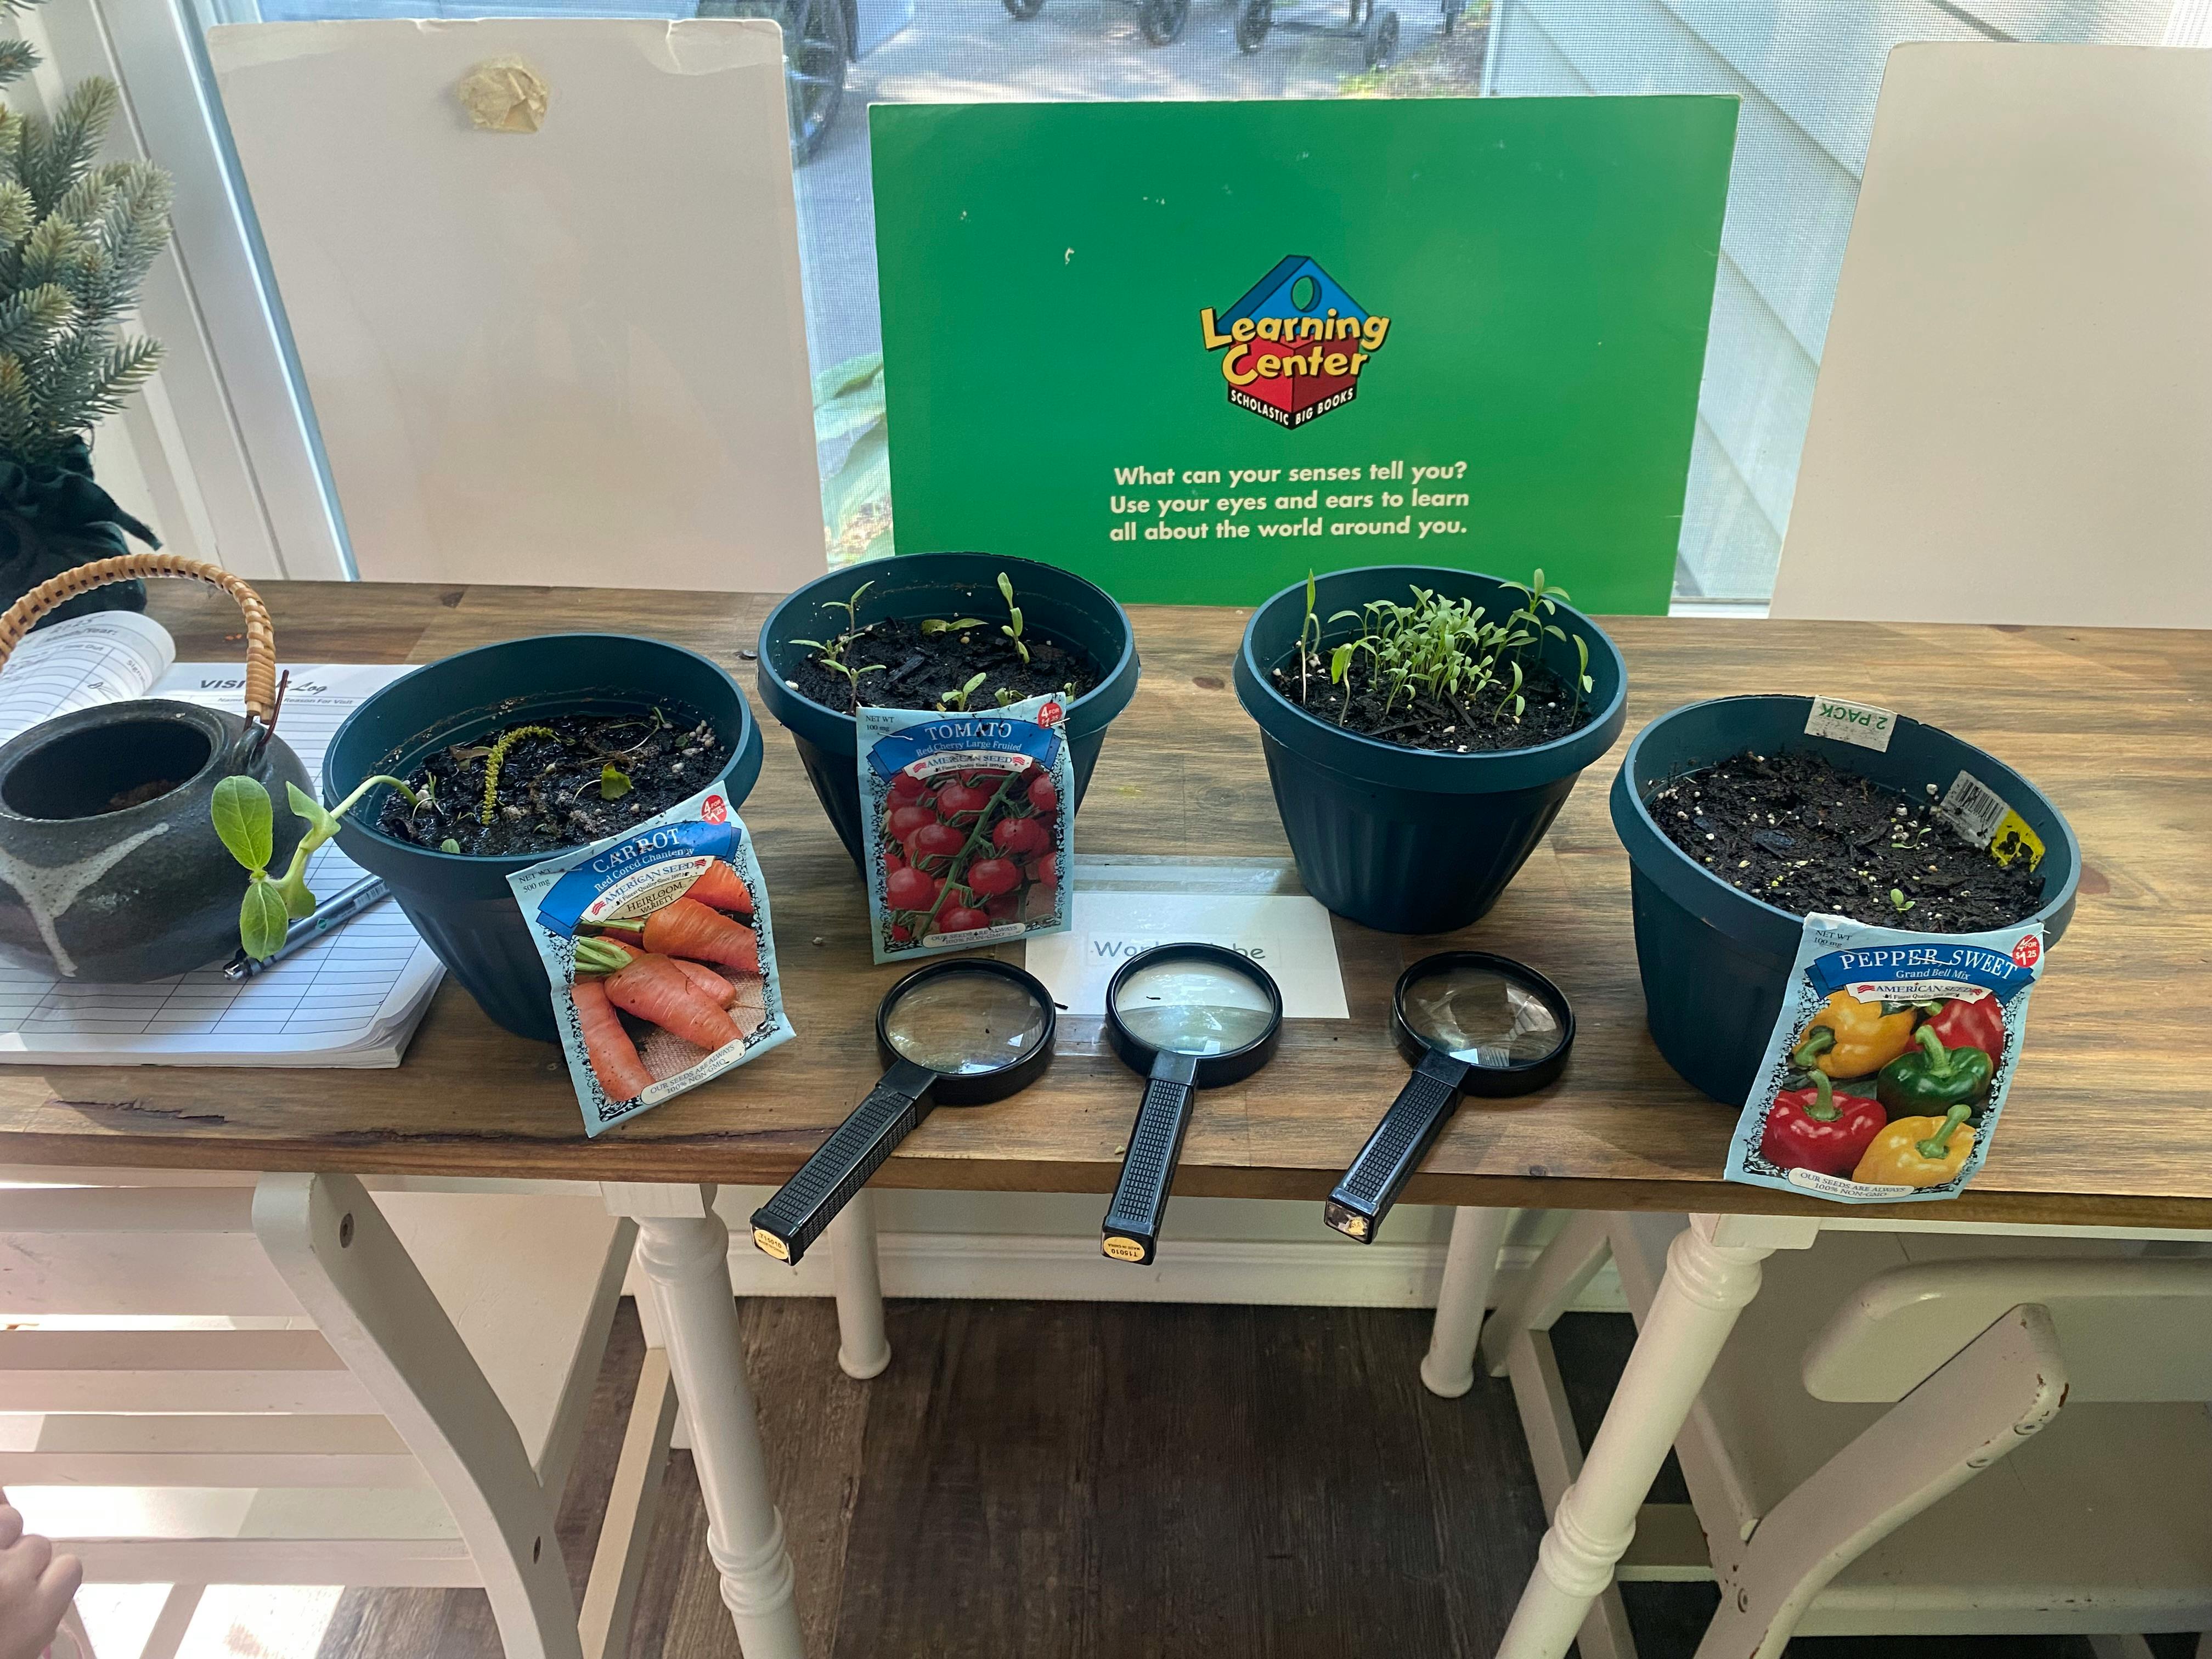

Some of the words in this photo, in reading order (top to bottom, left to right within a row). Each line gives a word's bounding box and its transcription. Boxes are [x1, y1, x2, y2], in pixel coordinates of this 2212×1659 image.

[1200, 307, 1390, 351] Learning
[1222, 343, 1369, 385] Center
[1231, 389, 1289, 426] SCHOLASTIC
[1295, 407, 1313, 426] BIG
[1317, 387, 1354, 414] BOOKS
[1114, 466, 1175, 486] What
[1182, 468, 1221, 483] can
[1228, 467, 1282, 488] your
[1288, 465, 1362, 482] senses
[1369, 461, 1403, 480] tell
[1411, 461, 1468, 485] you?
[1110, 495, 1150, 514] Use
[1158, 496, 1210, 517] your
[1216, 496, 1268, 516] eyes
[1274, 490, 1318, 510] and
[1325, 493, 1373, 509] ears
[1381, 492, 1404, 507] to
[1412, 489, 1470, 507] learn
[1109, 522, 1137, 541] all
[1144, 521, 1209, 541] about
[1216, 519, 1250, 539] the
[1257, 517, 1323, 537] world
[1330, 516, 1410, 535] around
[1418, 520, 1468, 539] you.
[289, 681, 328, 695] Log
[1041, 707, 1048, 718] 4
[1819, 703, 1871, 726] PACK
[924, 723, 1012, 741] TOMATO
[1876, 716, 1888, 730] 2
[916, 744, 932, 757] Red
[933, 742, 964, 752] Cherry
[966, 741, 991, 751] Large
[992, 741, 1022, 751] Fruited
[704, 801, 711, 813] 4
[711, 799, 721, 809] FOR
[592, 827, 681, 874] CARROT
[518, 872, 536, 884] NET
[523, 883, 537, 893] 500
[538, 879, 551, 888] mg
[594, 877, 614, 893] Red
[612, 861, 641, 882] Cored
[604, 870, 661, 905] AMERICAN
[663, 861, 695, 874] SEED
[622, 890, 638, 901] Finest
[638, 882, 657, 893] Quality
[628, 882, 682, 912] HEIRLOOM
[640, 894, 674, 913] VARIETY
[966, 933, 1006, 942] NON-GMO
[2017, 939, 2025, 951] 4
[1896, 969, 1931, 978] Grand
[1951, 969, 1971, 980] Mix
[1949, 950, 2018, 980] SWEET
[650, 1082, 669, 1094] OUR
[669, 1070, 694, 1086] SEEDS
[696, 1063, 708, 1075] ARE
[708, 1044, 735, 1065] ALWAYS
[667, 1081, 687, 1094] 100%
[689, 1058, 726, 1084] NON-GMO
[1800, 1172, 1821, 1183] OUR
[1823, 1178, 1851, 1189] SEEDS
[1814, 1183, 1838, 1192] 100%
[1840, 1188, 1887, 1197] NON-GMO
[759, 1233, 782, 1248] T15010
[1111, 1249, 1138, 1257] T15010
